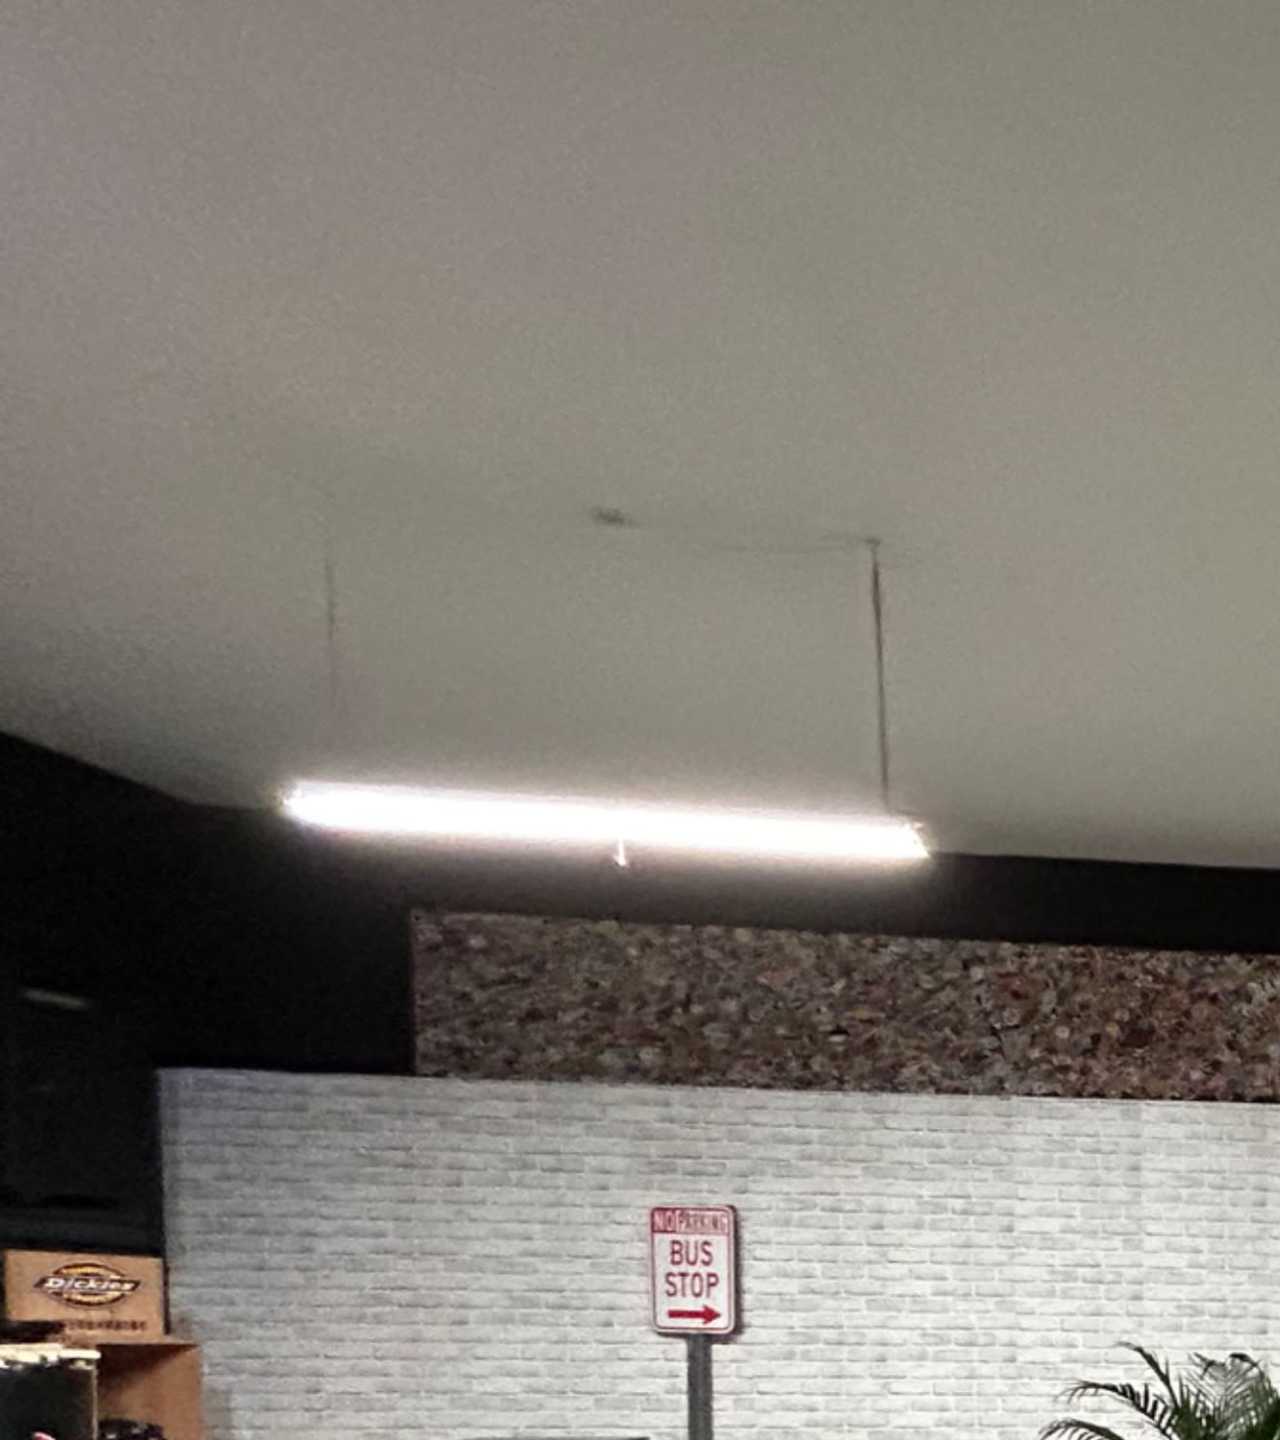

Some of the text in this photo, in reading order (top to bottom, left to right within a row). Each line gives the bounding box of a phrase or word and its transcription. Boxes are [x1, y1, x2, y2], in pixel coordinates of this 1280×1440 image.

[654, 1211, 729, 1232] NO PARKING
[669, 1240, 714, 1266] BUS
[44, 1276, 136, 1291] Dickies
[664, 1271, 719, 1298] STOP
